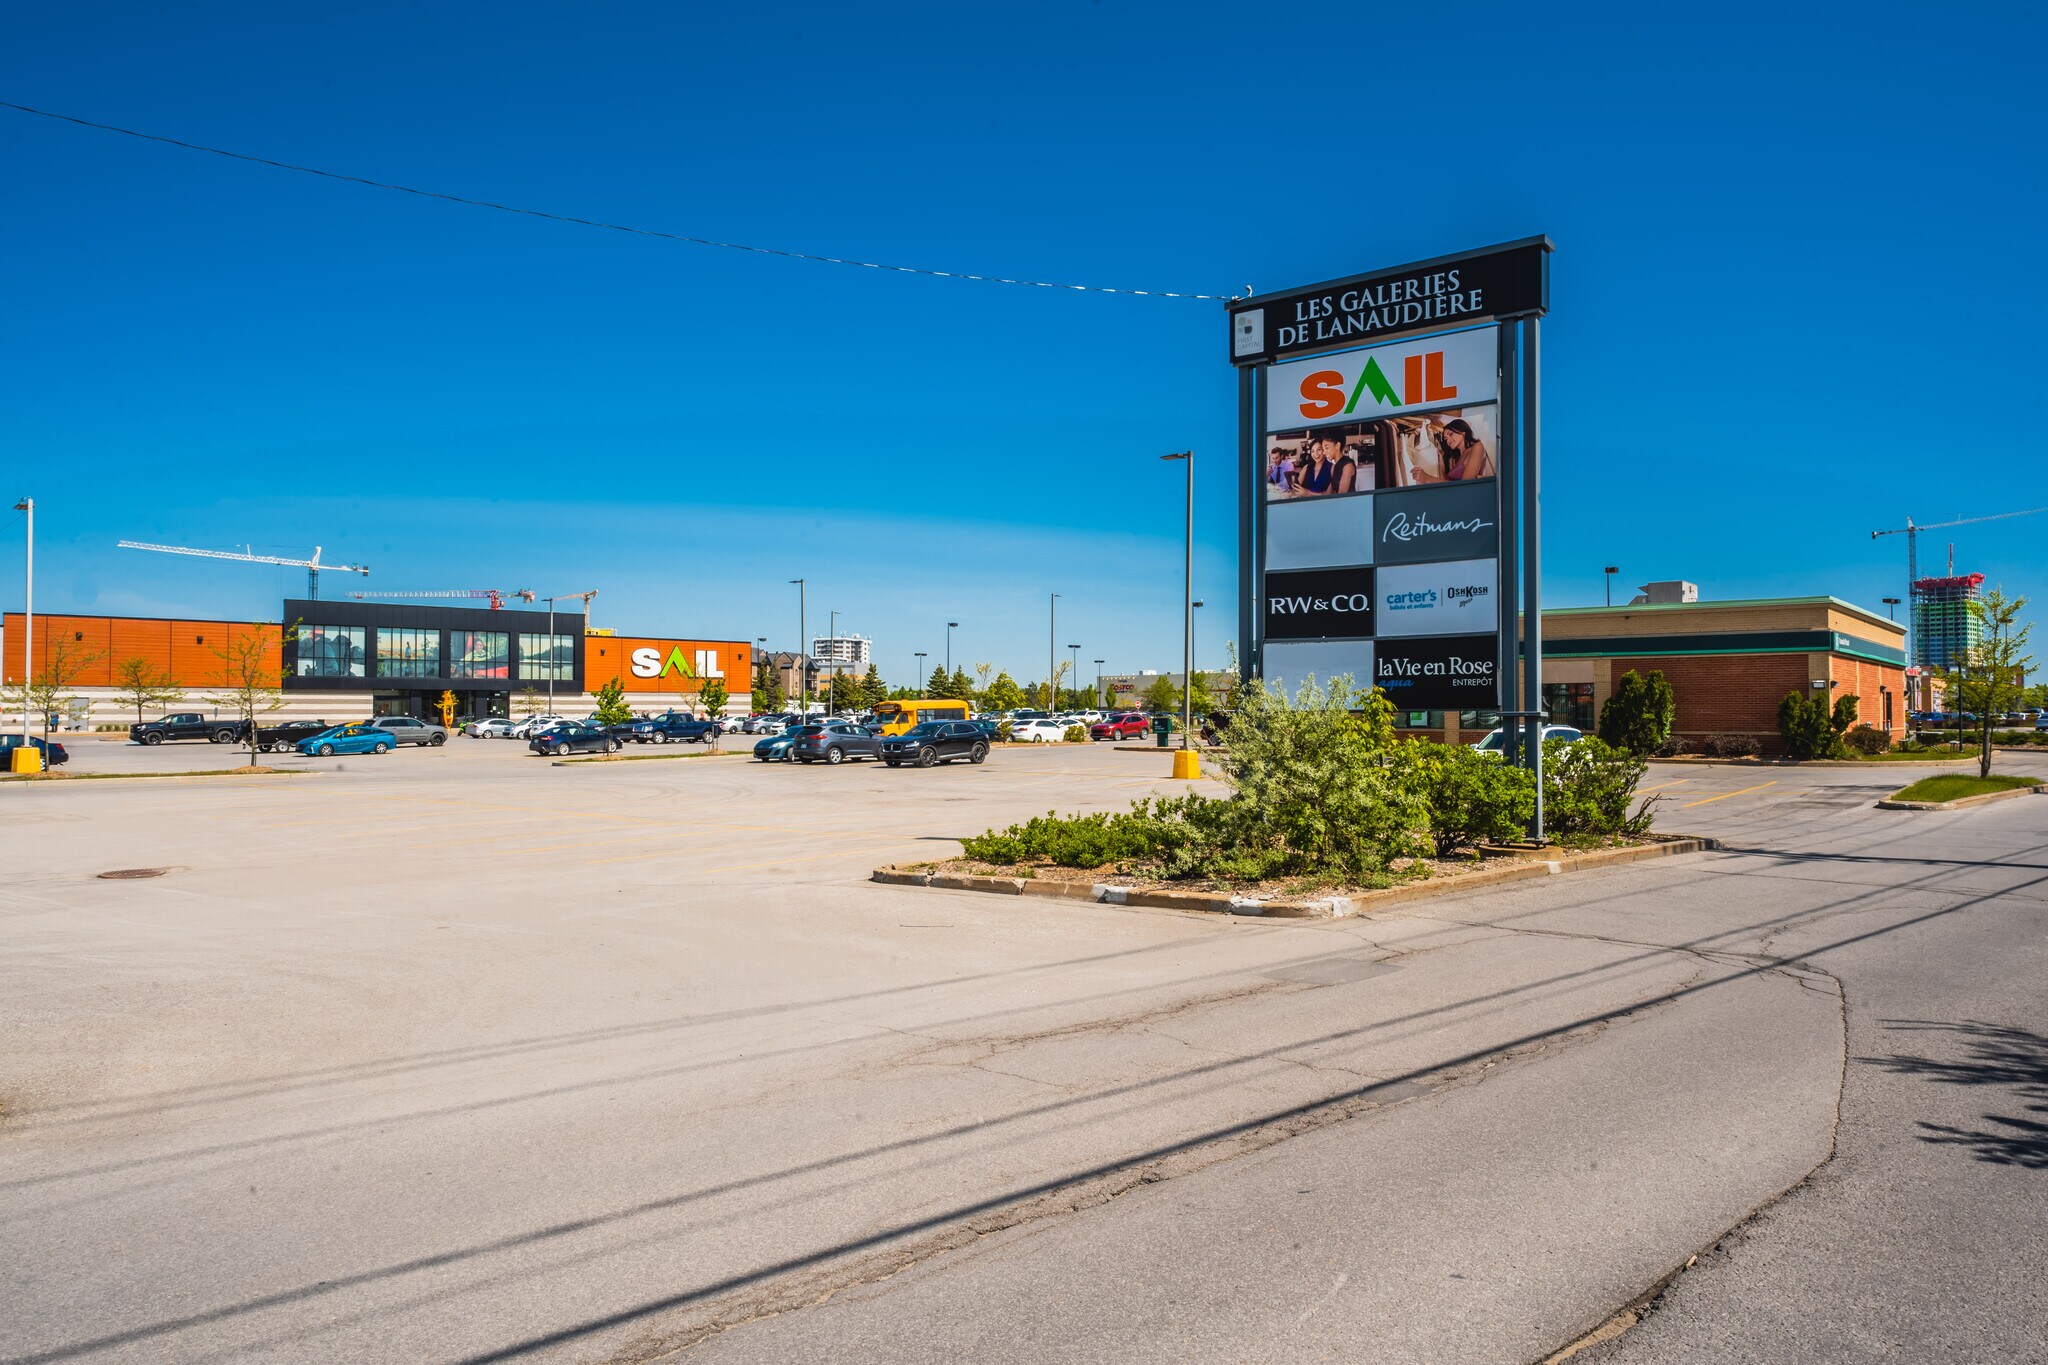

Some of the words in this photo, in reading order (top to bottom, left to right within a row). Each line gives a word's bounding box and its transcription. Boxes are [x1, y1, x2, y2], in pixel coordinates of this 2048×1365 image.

[1296, 296, 1333, 322] LES
[1340, 270, 1460, 312] GALERIES
[1278, 325, 1309, 347] DE
[1316, 289, 1483, 340] LANAUDIÈRE
[1299, 351, 1458, 420] SAIL
[1382, 512, 1494, 543] Reitmans
[1386, 589, 1437, 604] carter's
[631, 644, 725, 679] SAIL
[1424, 662, 1445, 675] en
[1448, 657, 1493, 675] Rose
[1379, 679, 1414, 692] aqua
[1452, 676, 1493, 687] ENTREPÔT
